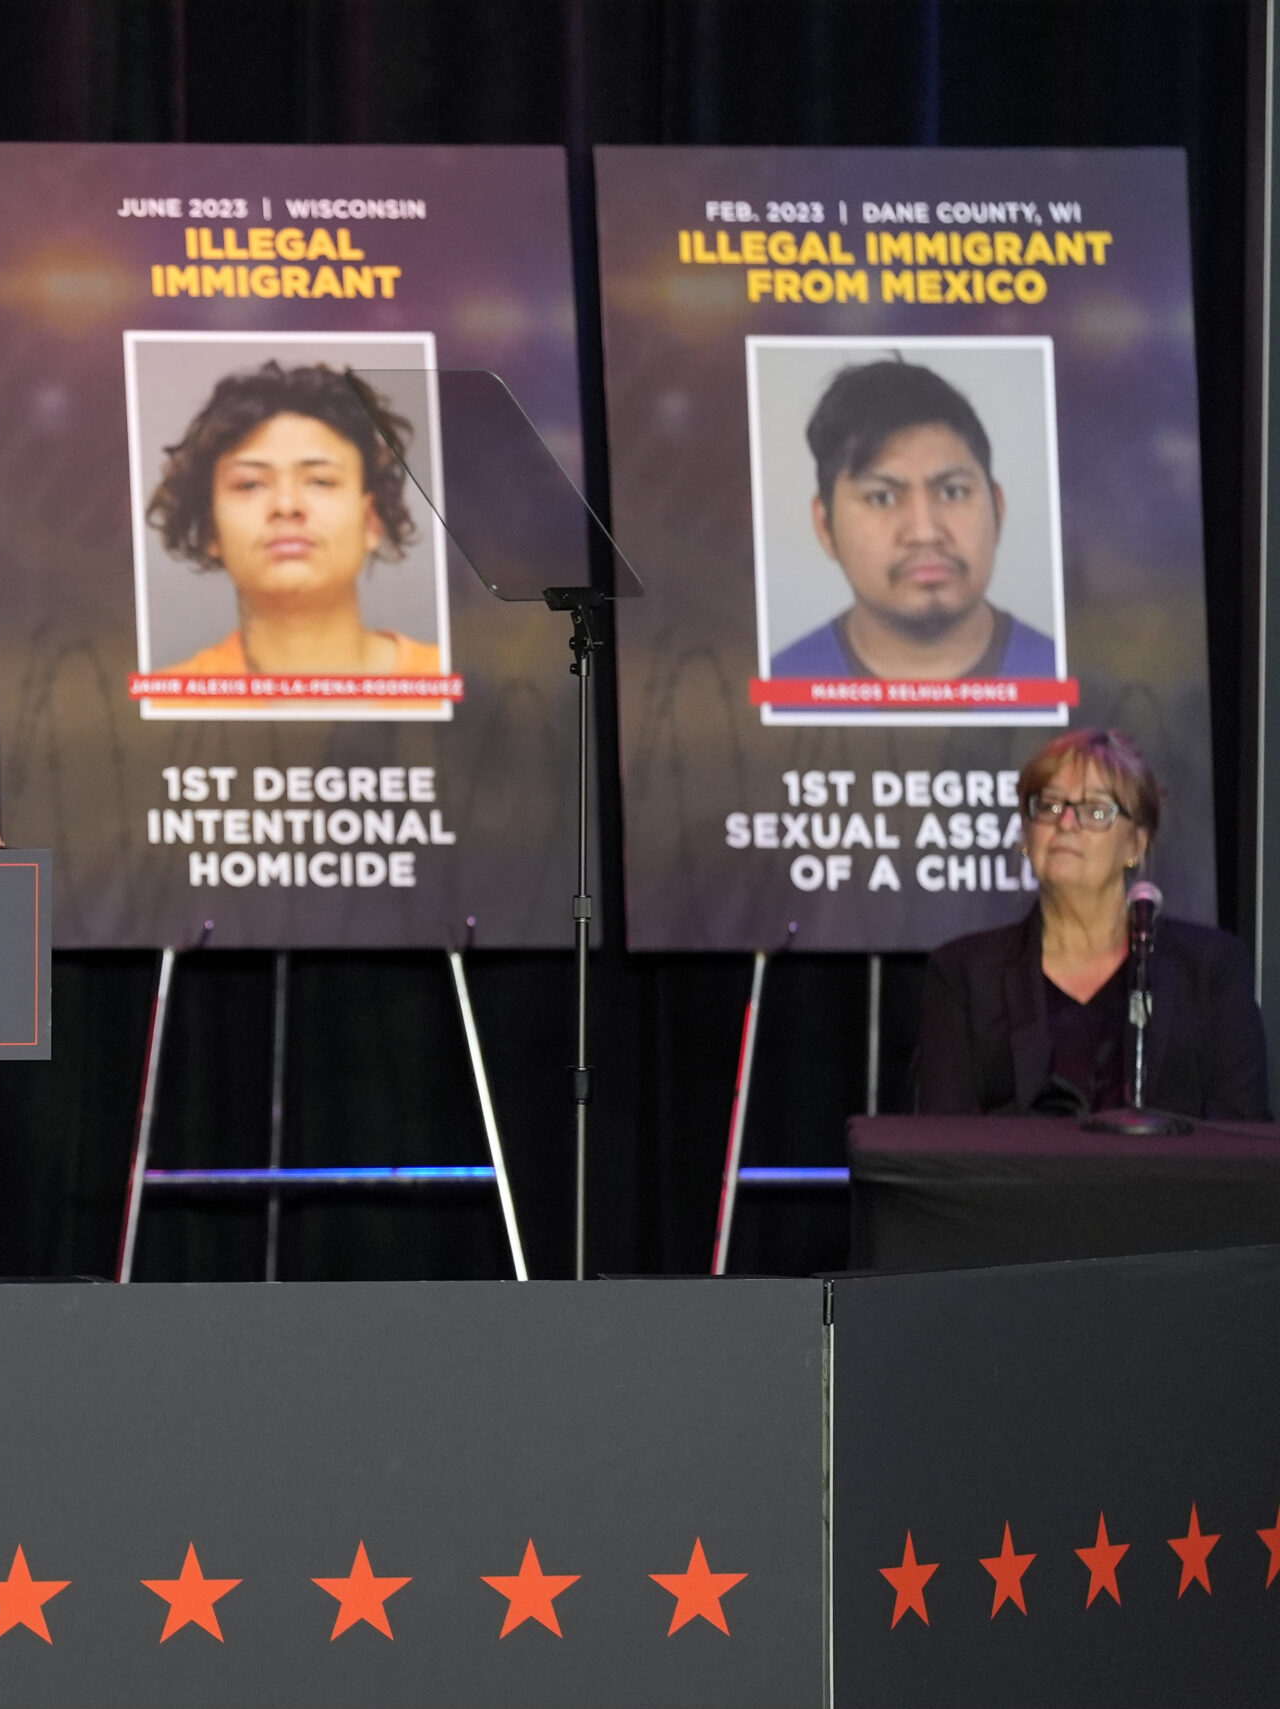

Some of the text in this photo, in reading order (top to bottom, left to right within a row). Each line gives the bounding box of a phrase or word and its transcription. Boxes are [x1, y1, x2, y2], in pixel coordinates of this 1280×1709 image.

[118, 197, 182, 218] JUNE
[188, 198, 248, 219] 2023
[286, 198, 426, 219] WISCONSIN
[706, 201, 760, 223] FEB.
[766, 201, 824, 223] 2023
[862, 202, 930, 224] DANE
[936, 202, 1042, 226] COUNTY,
[1049, 202, 1082, 224] WI
[185, 227, 364, 261] ILLEGAL
[678, 231, 1113, 266] ILLEGAL IMMIGRANT
[151, 265, 401, 299] IMMIGRANT
[747, 270, 1047, 304] FROM MEXICO
[162, 766, 436, 803] 1ST DEGREE
[782, 770, 1020, 808] 1ST DEGRE
[147, 809, 456, 846] INTENTIONAL
[725, 812, 1024, 850] SEXUAL ASSA
[188, 851, 417, 888] HOMICIDE
[790, 854, 853, 891] OF
[868, 854, 902, 891] A
